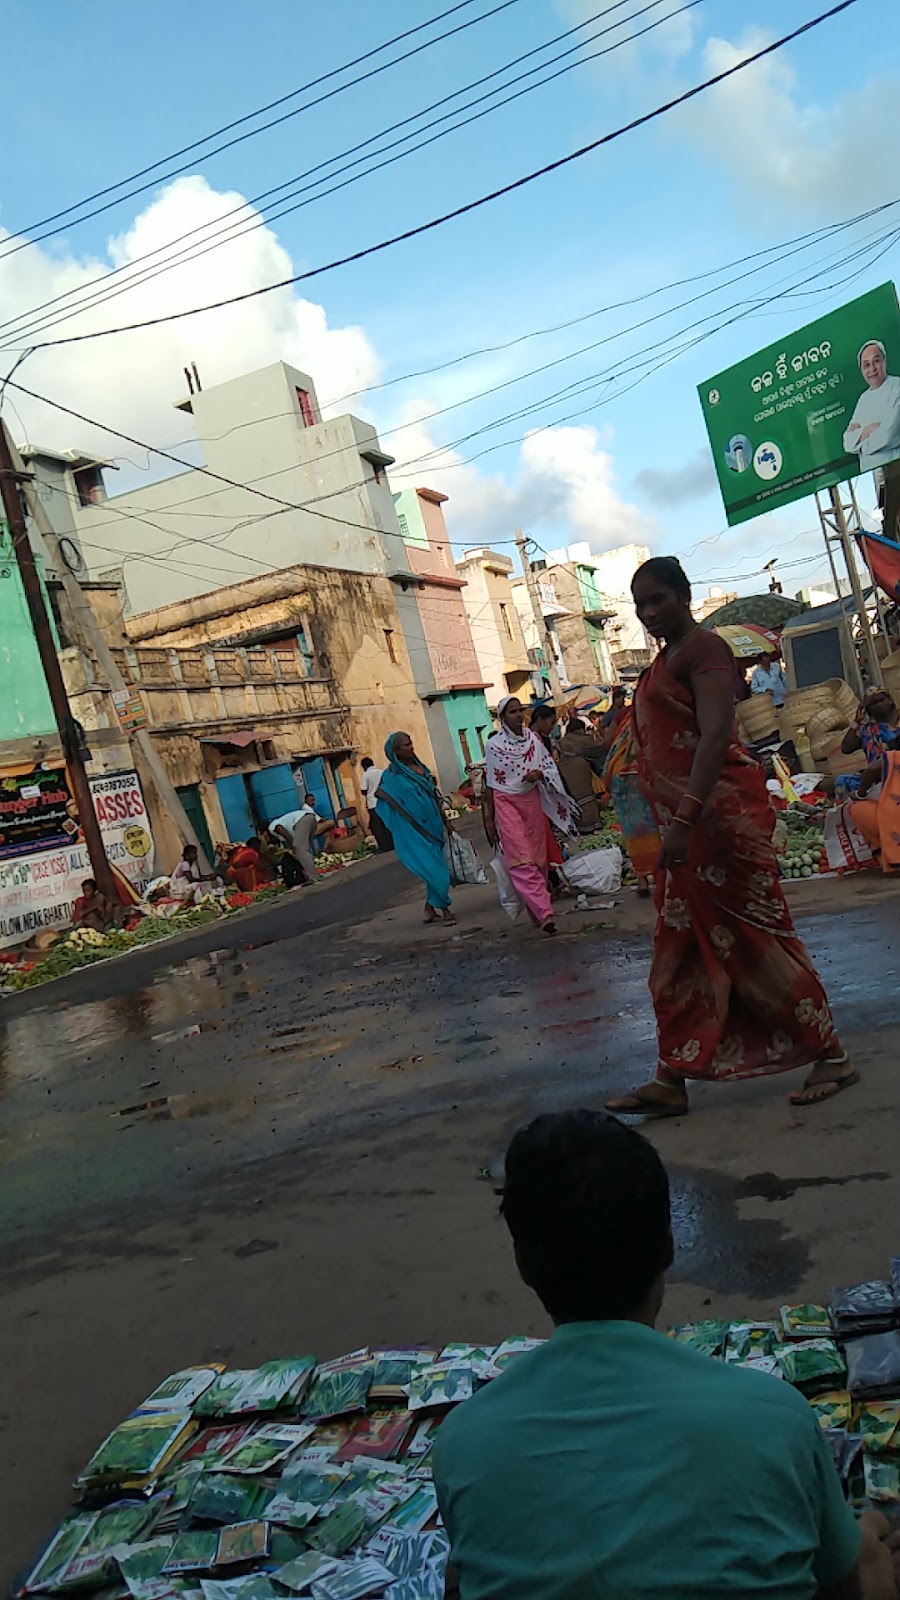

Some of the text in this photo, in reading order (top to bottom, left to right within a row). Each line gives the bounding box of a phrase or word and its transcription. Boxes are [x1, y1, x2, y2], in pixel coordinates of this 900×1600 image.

[751, 341, 832, 392] ଜଳ ହିଁ ଜୀବନ
[41, 789, 67, 806] Hub
